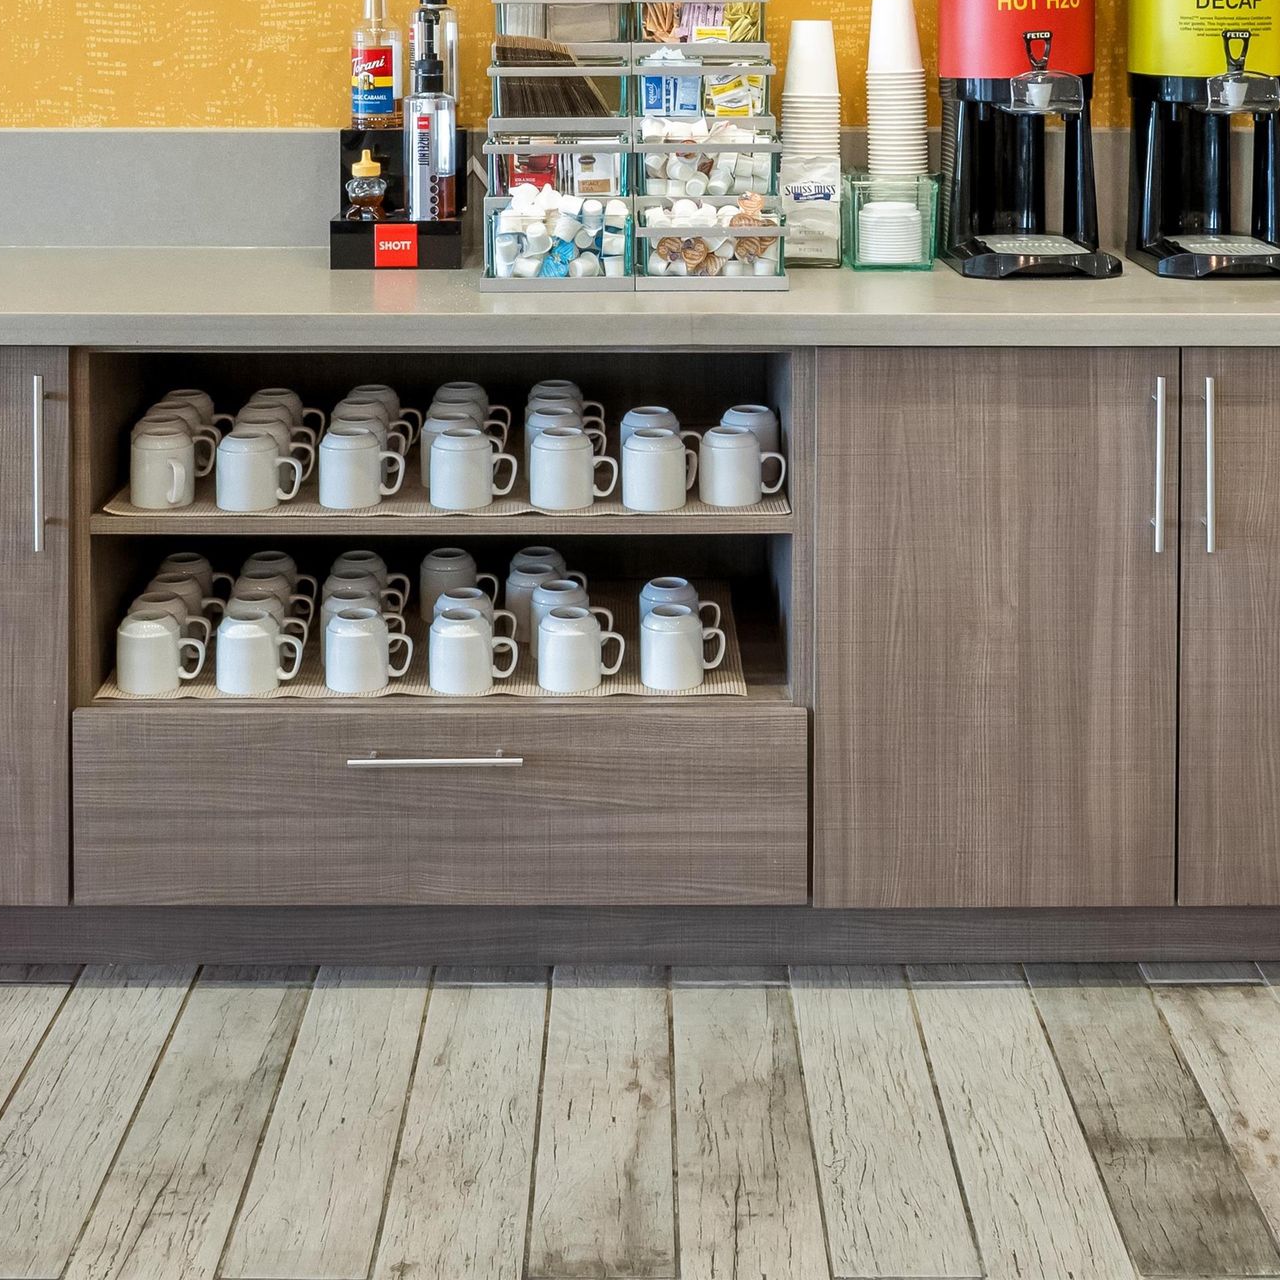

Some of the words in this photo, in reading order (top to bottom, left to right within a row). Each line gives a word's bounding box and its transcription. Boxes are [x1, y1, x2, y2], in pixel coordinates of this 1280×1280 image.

[352, 55, 385, 77] Torani
[646, 82, 658, 104] equal
[417, 132, 430, 166] HAZELNUT
[379, 240, 412, 251] SHOTT
